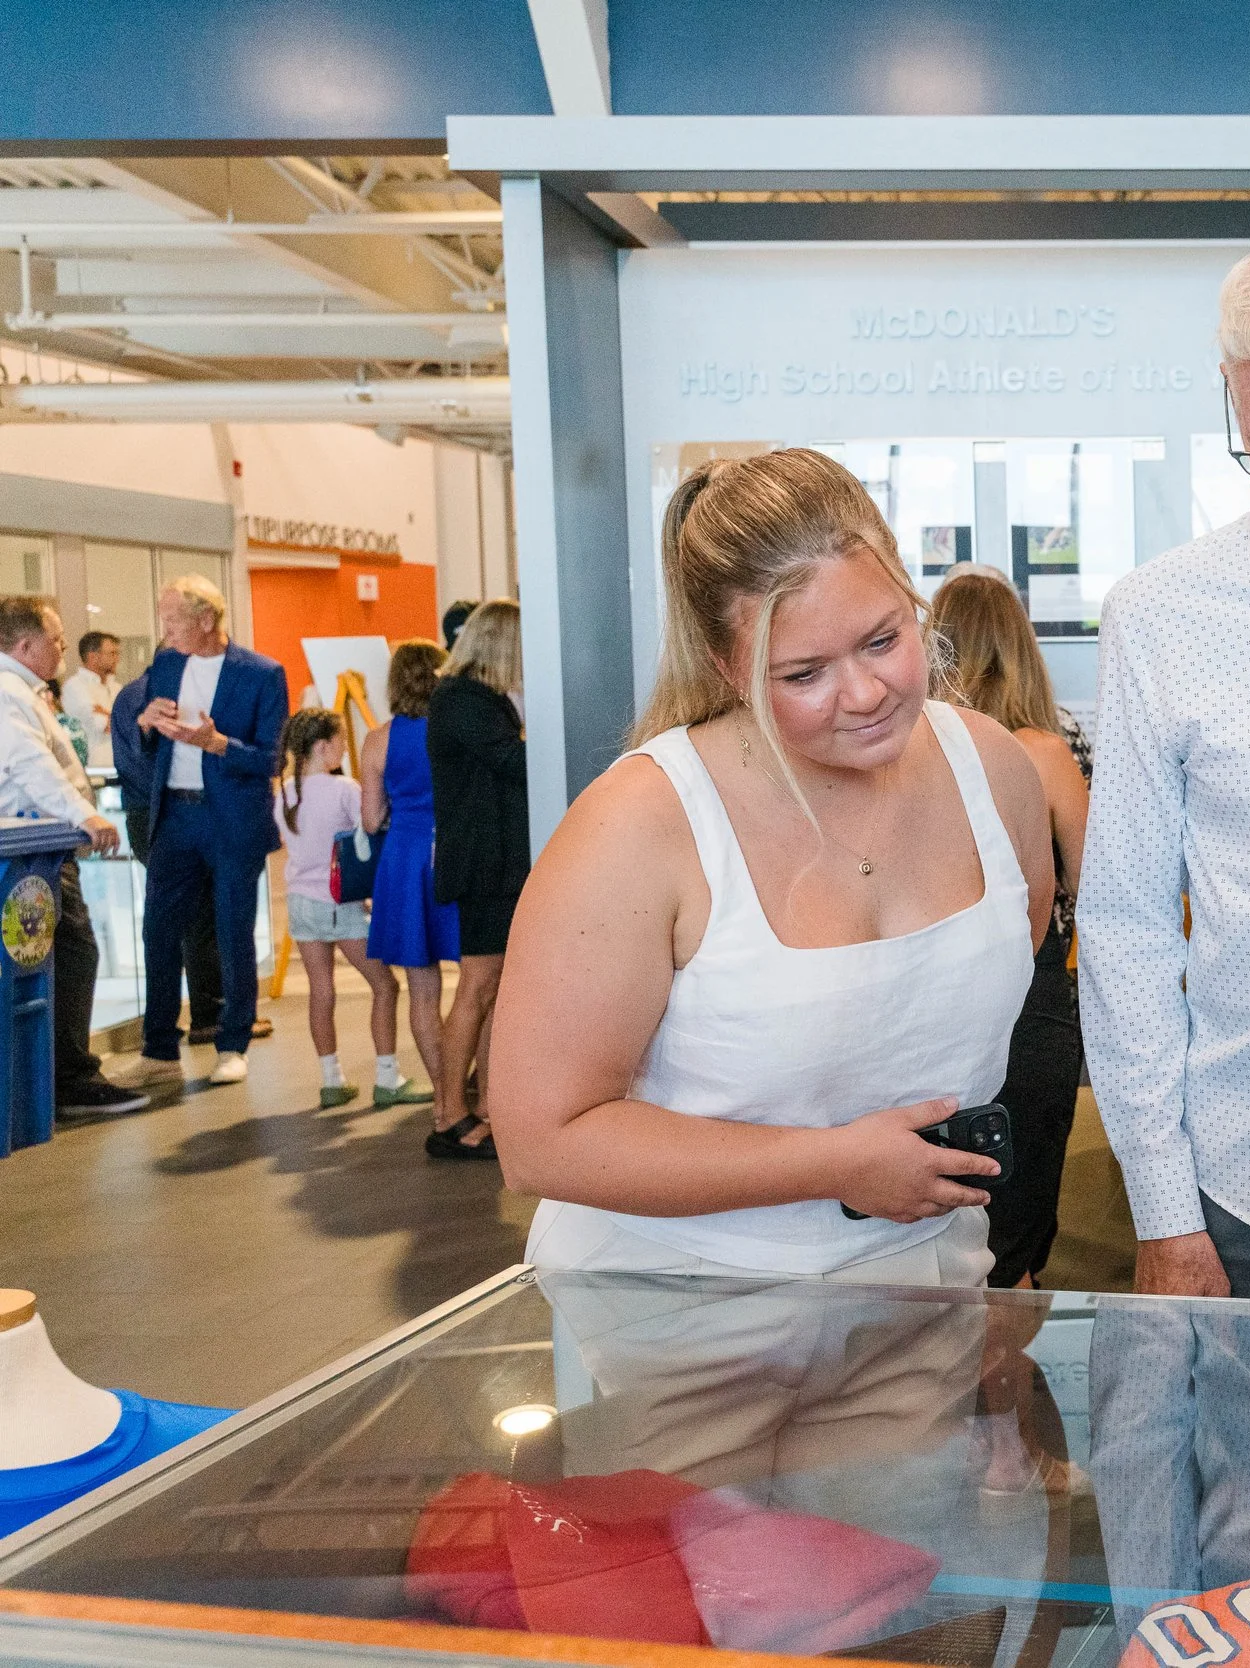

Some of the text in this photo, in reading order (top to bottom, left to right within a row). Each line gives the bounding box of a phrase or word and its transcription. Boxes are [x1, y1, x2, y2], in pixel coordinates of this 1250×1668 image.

[852, 305, 1115, 340] McDONALD'S
[680, 360, 768, 403] High
[781, 359, 914, 394] School
[928, 359, 1066, 393] Athlete
[1079, 360, 1118, 392] of
[1130, 357, 1193, 393] the
